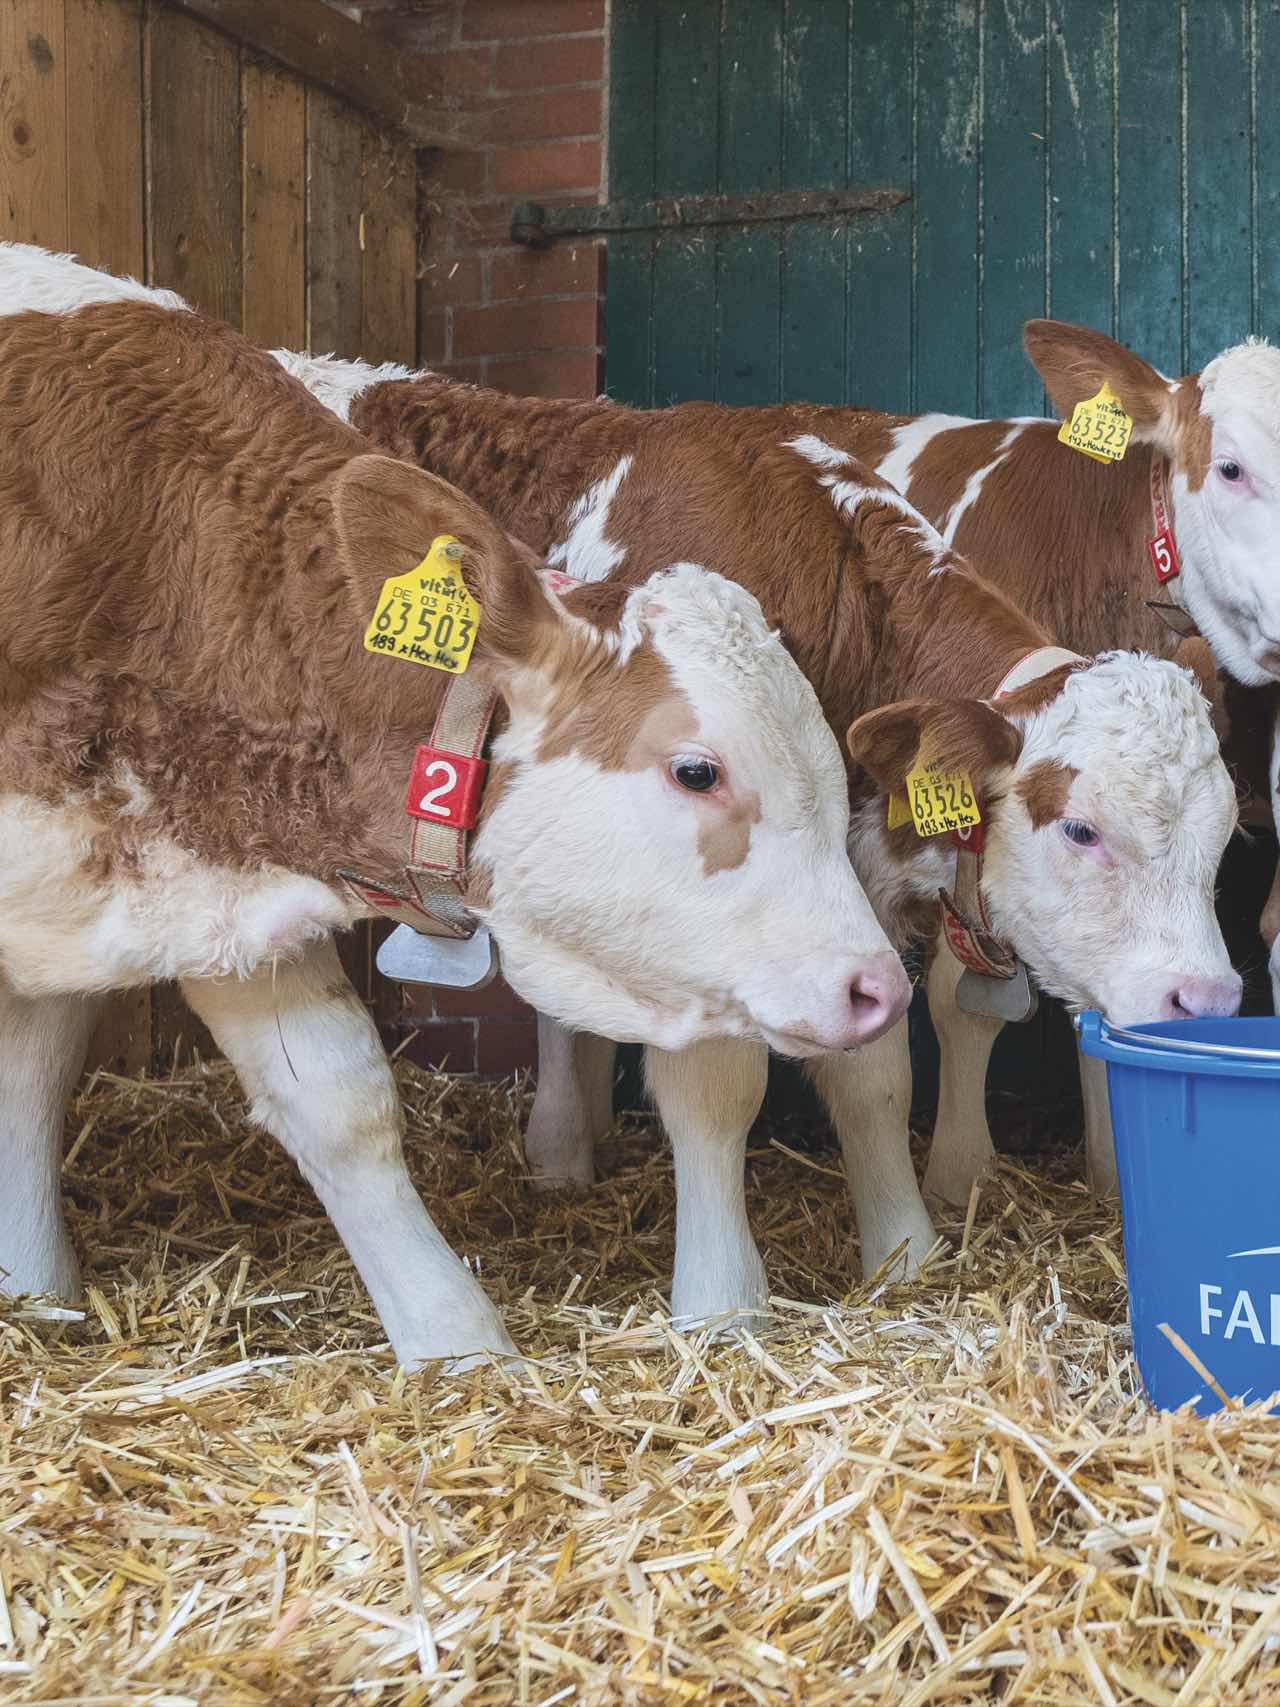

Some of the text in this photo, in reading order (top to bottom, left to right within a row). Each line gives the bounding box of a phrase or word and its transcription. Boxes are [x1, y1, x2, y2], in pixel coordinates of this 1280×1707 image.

[1154, 537, 1172, 573] 5
[392, 586, 471, 618] DE 03 671
[369, 633, 396, 651] 189
[419, 760, 457, 817] 2
[913, 777, 924, 789] DE
[919, 818, 938, 835] 193
